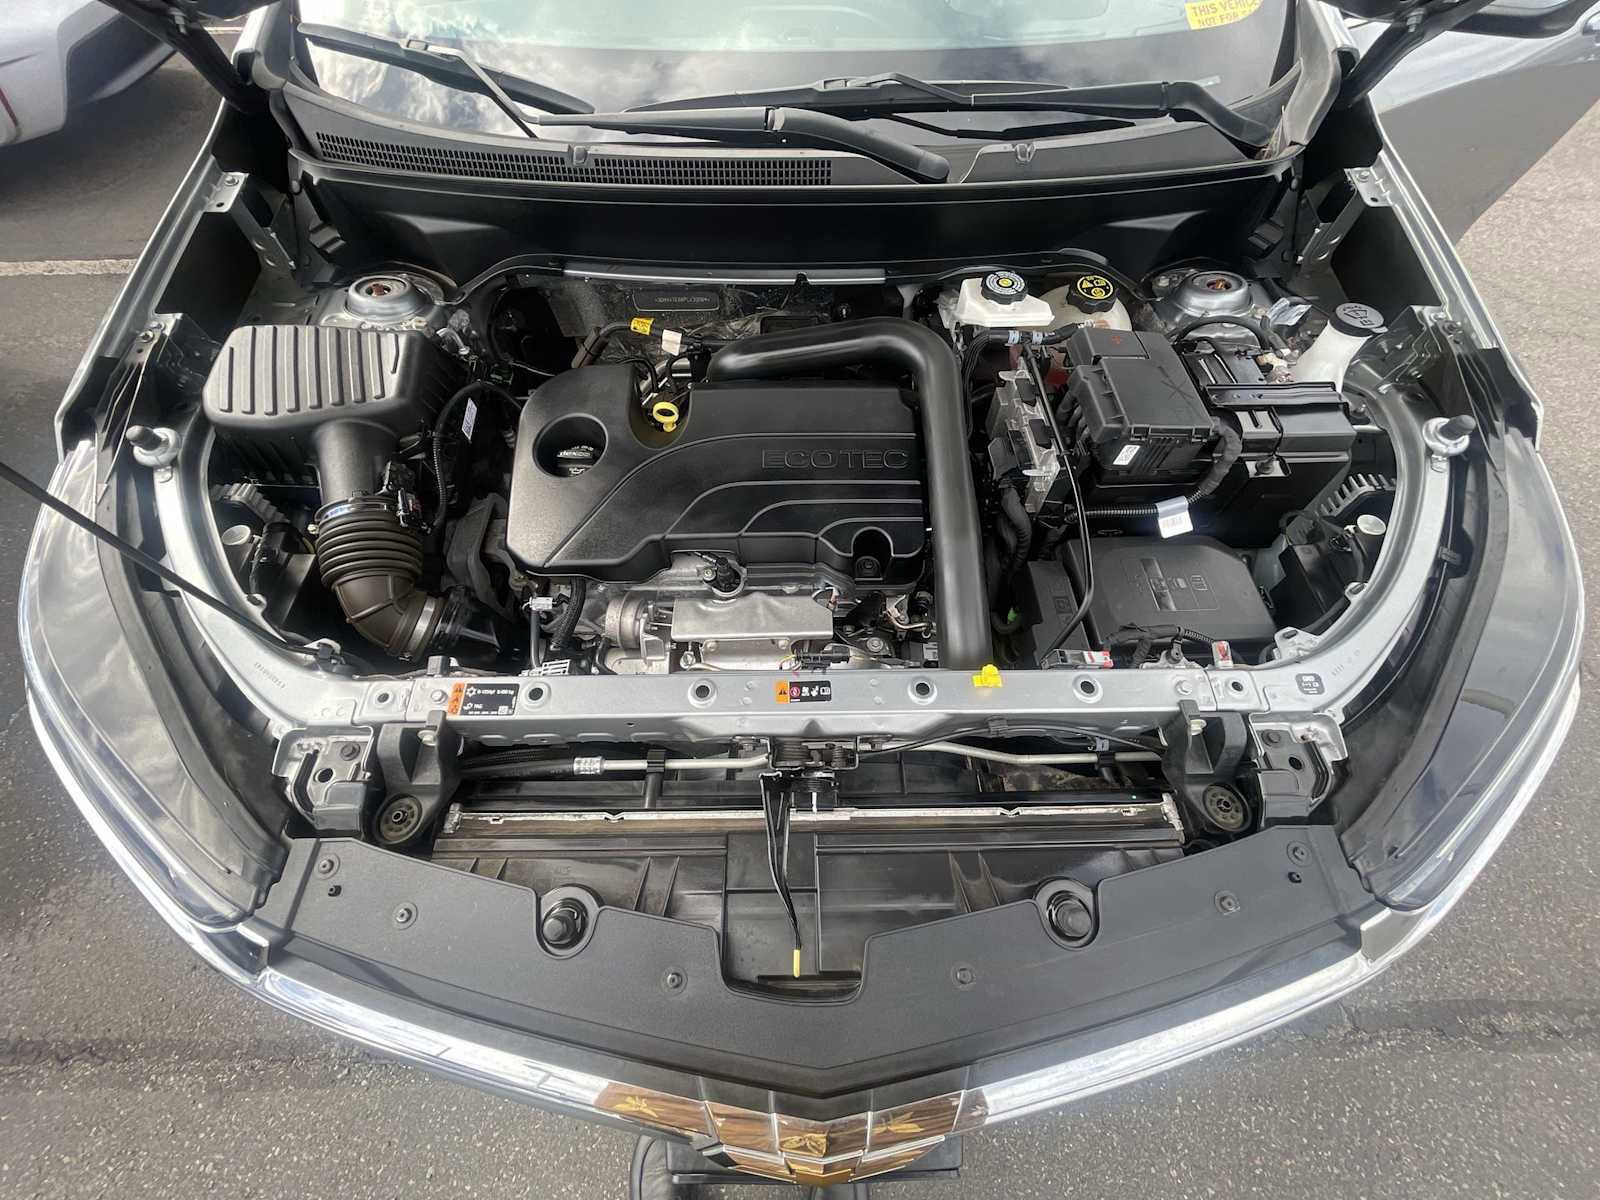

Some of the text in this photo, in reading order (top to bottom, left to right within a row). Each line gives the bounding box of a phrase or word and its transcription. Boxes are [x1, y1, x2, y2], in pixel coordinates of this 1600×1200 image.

[1191, 3, 1218, 17] THIS
[1197, 15, 1217, 27] NOT
[761, 449, 909, 469] ECOTEC
